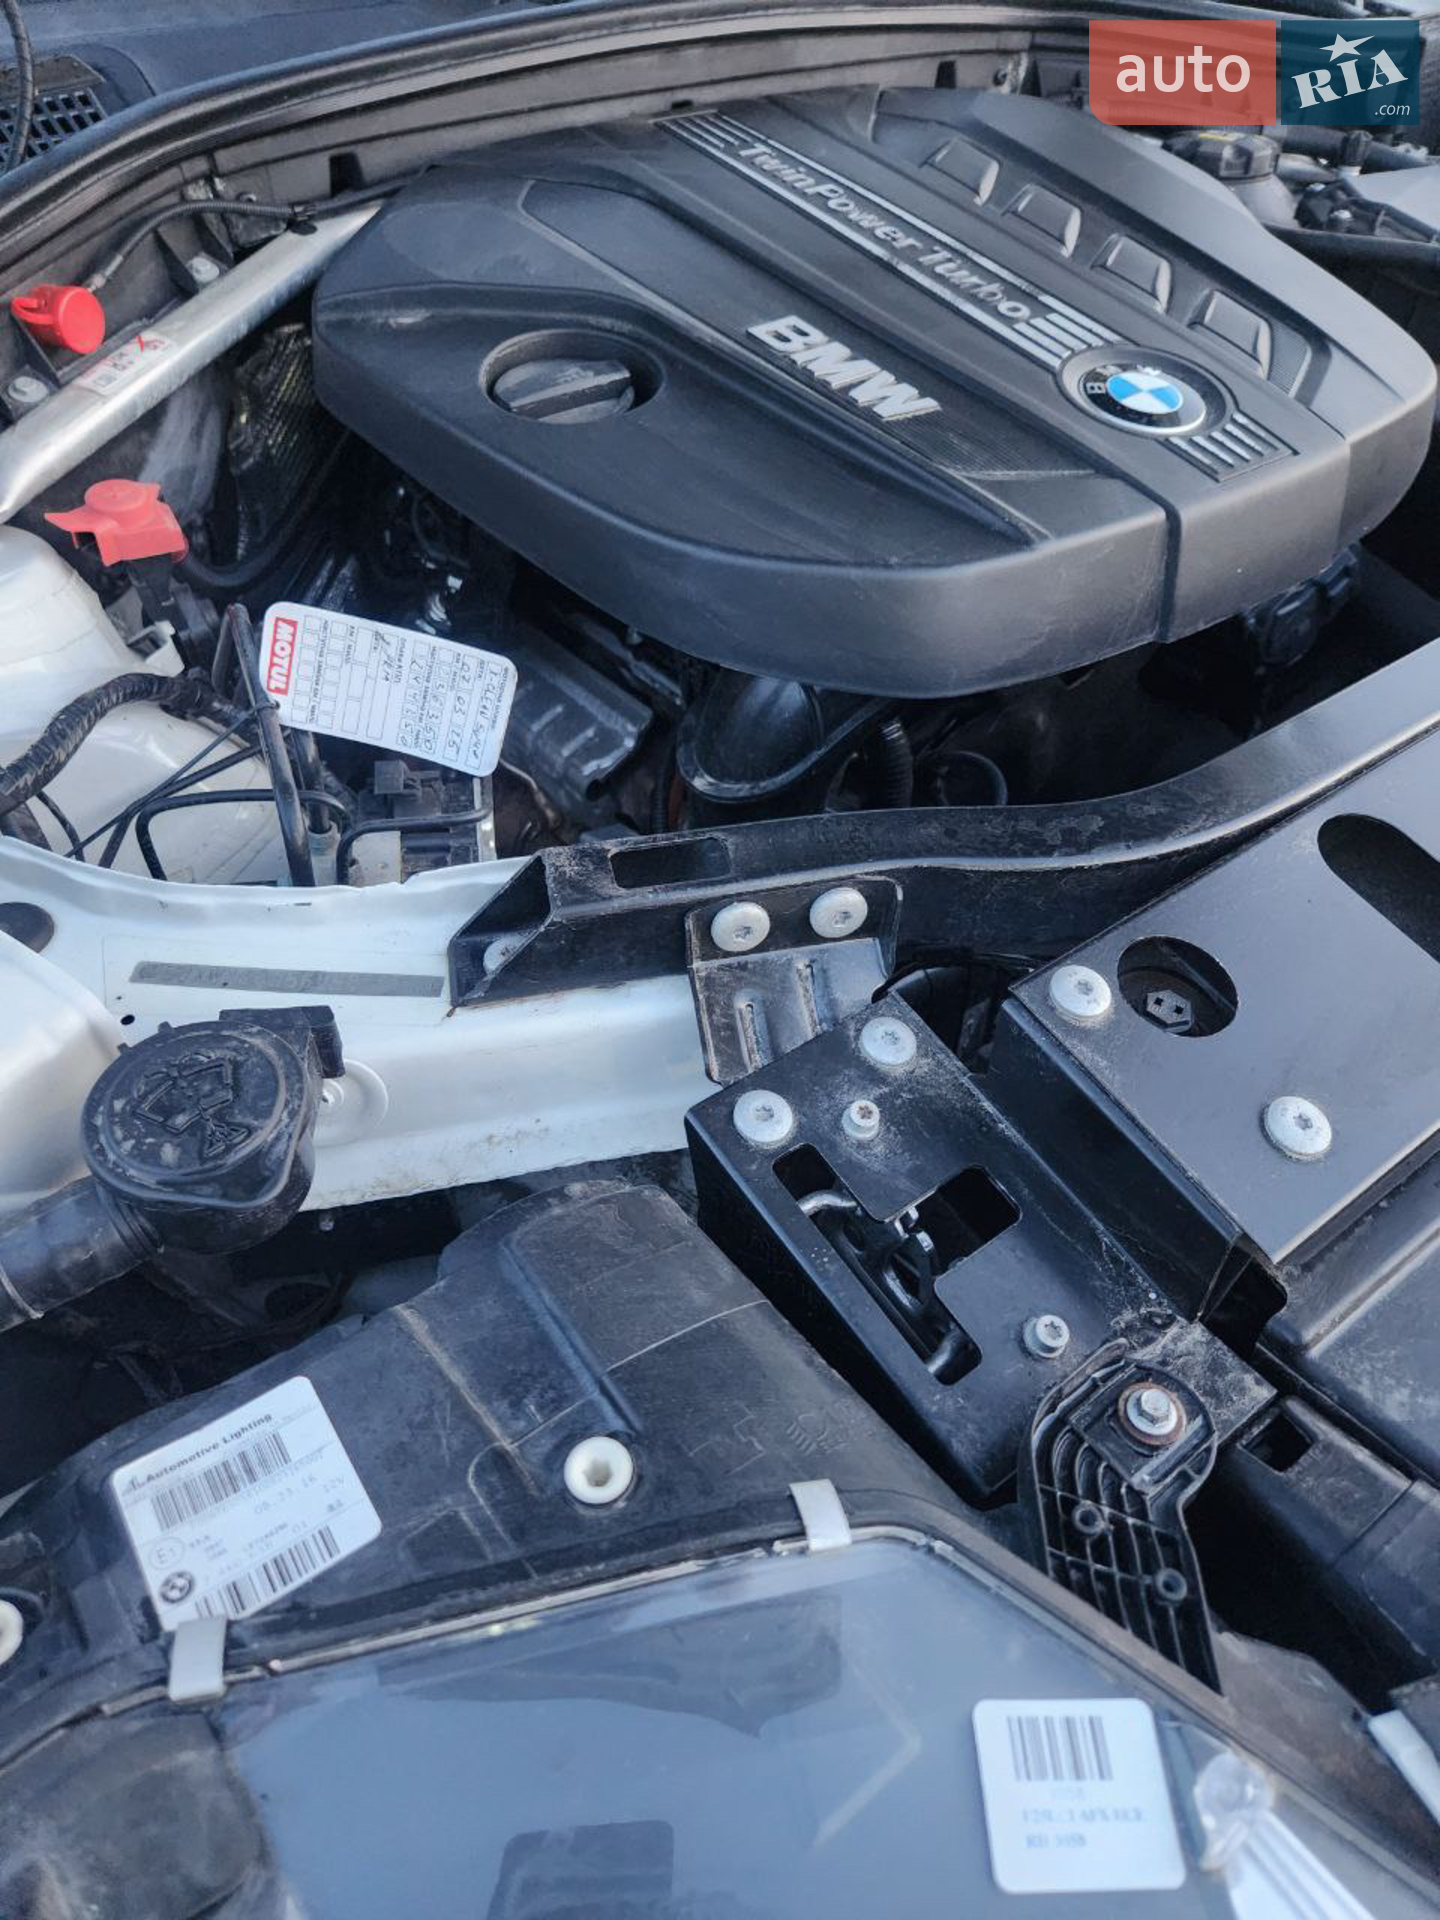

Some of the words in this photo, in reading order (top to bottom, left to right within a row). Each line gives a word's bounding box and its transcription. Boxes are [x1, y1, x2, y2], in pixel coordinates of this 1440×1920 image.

[738, 142, 923, 251] TwinPower
[918, 246, 1031, 320] Turbo
[746, 315, 942, 422] BMW
[270, 620, 294, 692] MOTUL
[145, 1441, 220, 1483] Automotive
[222, 1413, 273, 1445] Lighting
